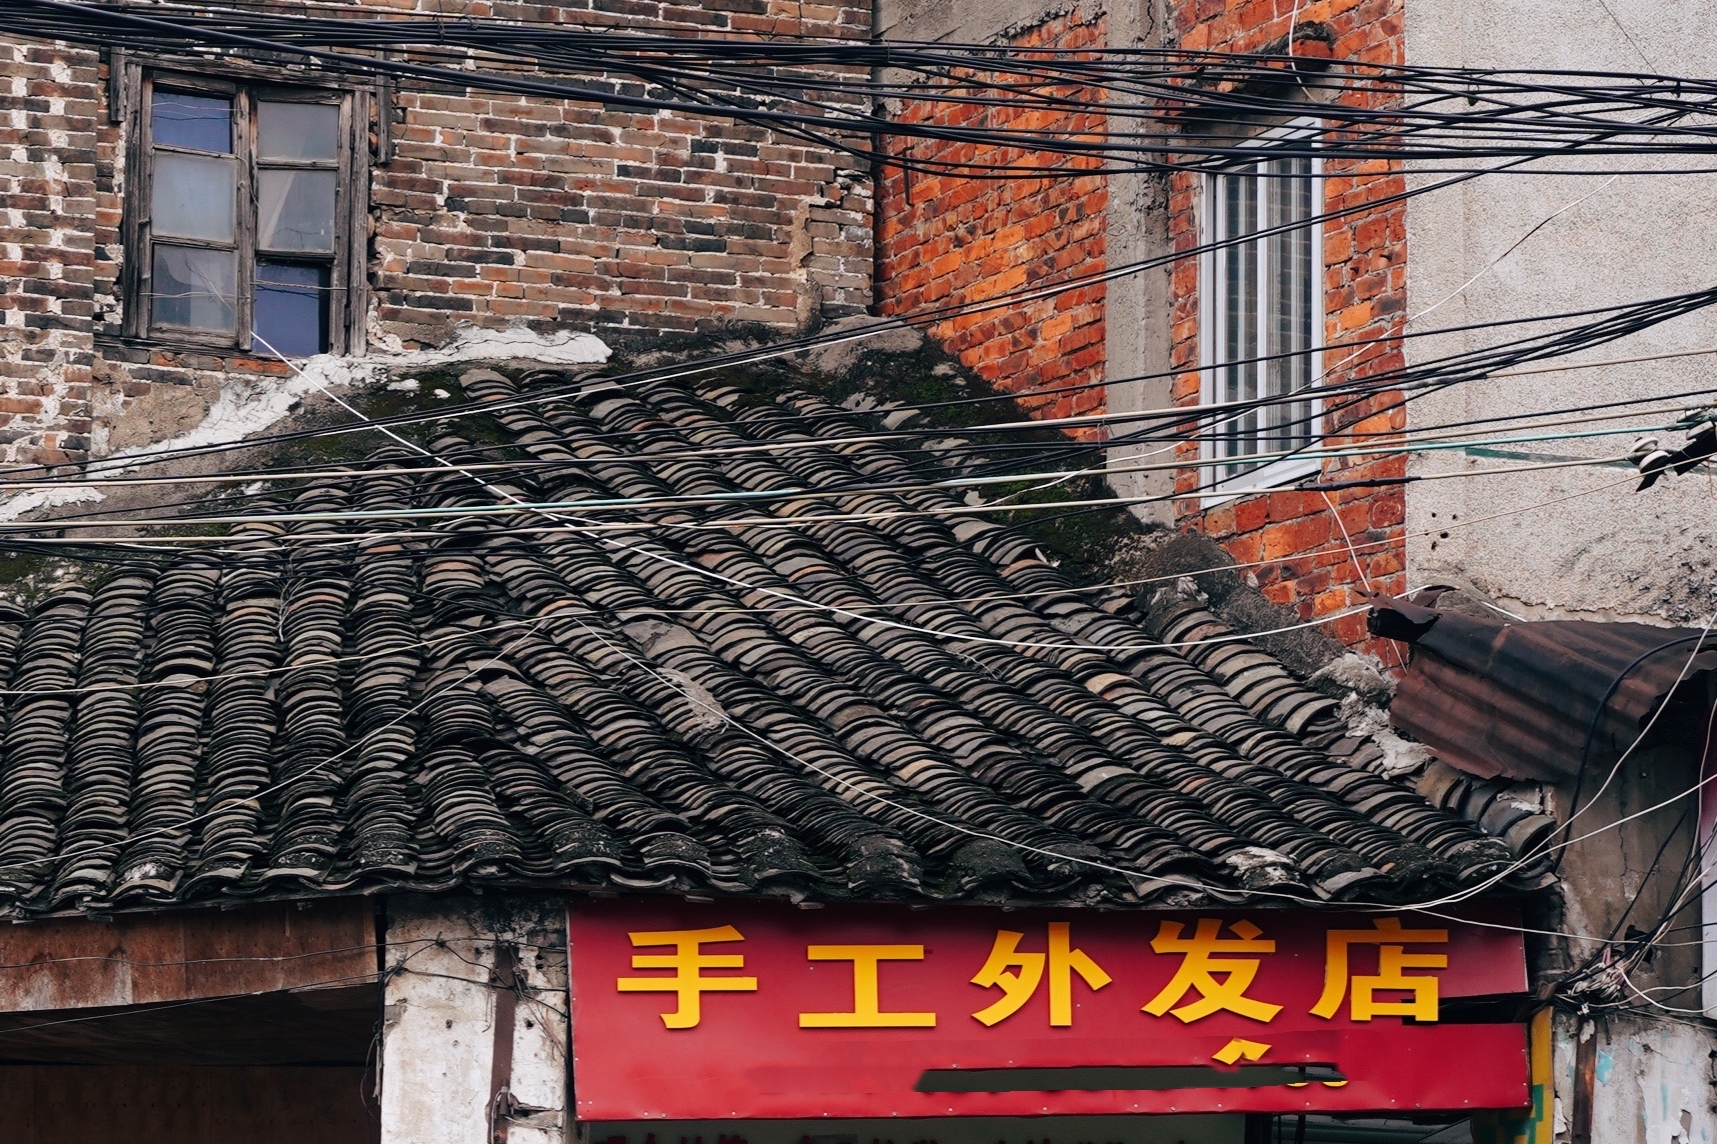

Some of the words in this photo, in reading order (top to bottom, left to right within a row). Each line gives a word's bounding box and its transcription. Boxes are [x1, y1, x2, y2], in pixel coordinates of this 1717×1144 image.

[615, 917, 1450, 1030] 手工外发店
